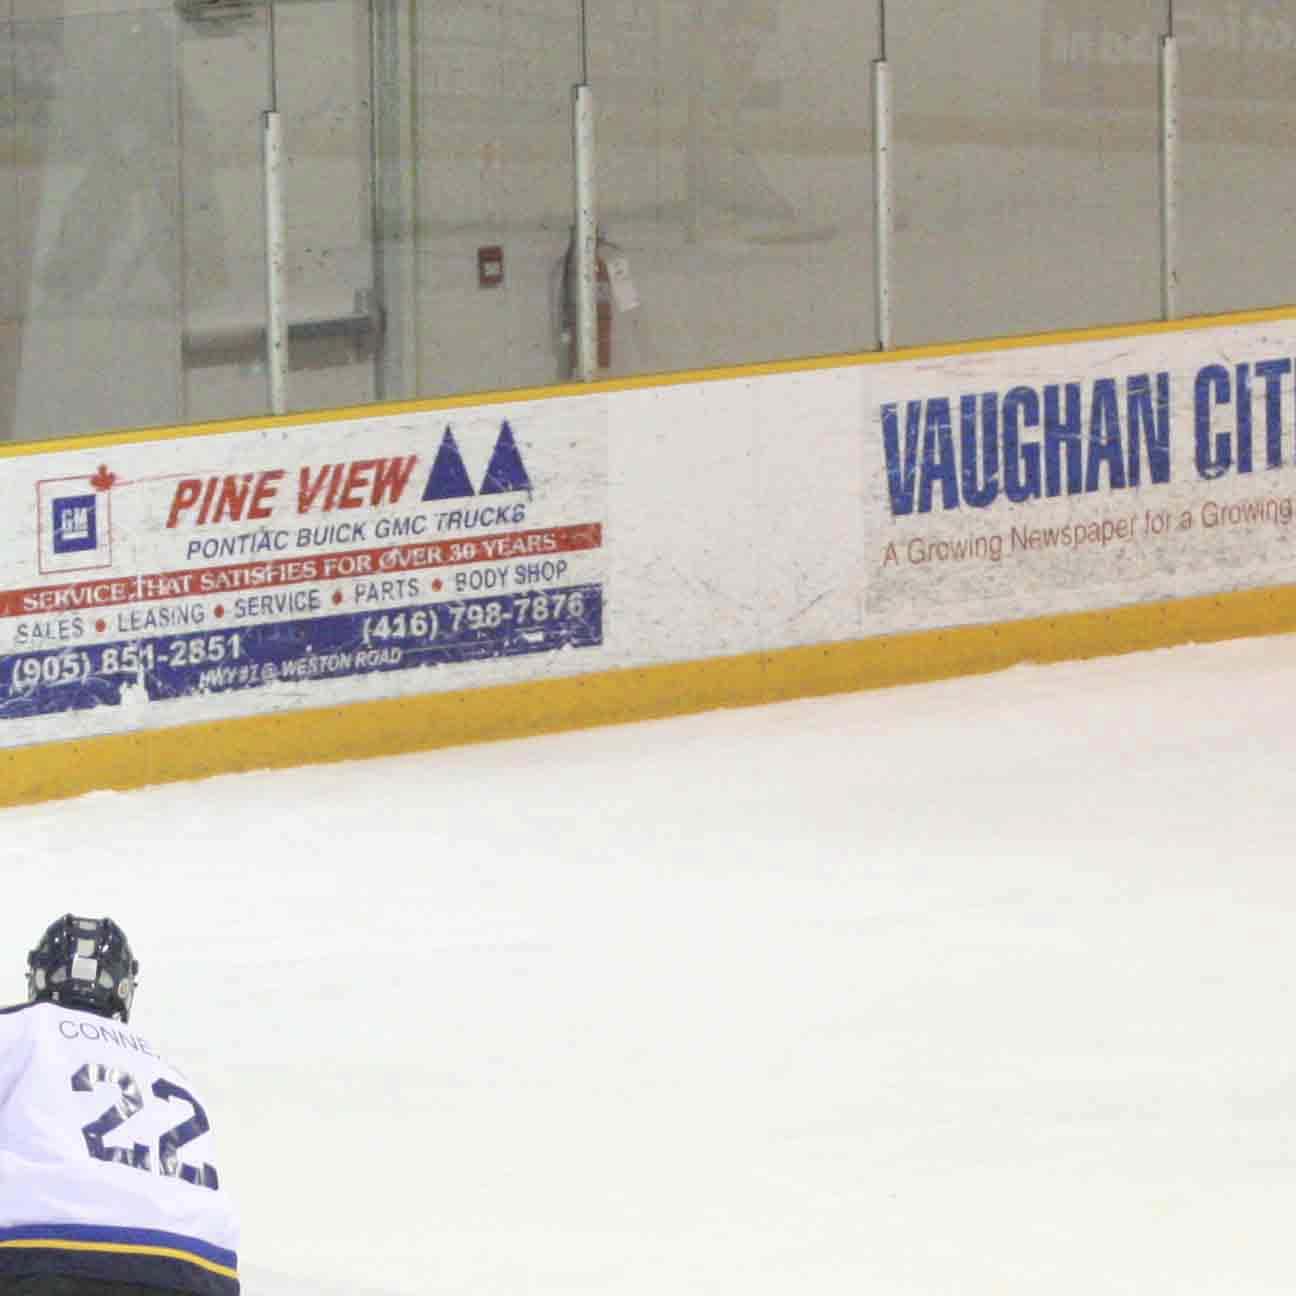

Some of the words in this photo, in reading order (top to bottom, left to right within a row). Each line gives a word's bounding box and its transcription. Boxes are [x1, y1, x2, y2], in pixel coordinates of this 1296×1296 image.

[880, 371, 1171, 516] VAUGHAN
[61, 506, 90, 534] GM
[166, 469, 286, 529] PINE
[296, 454, 419, 514] VIEW
[187, 529, 291, 560] PONTIAC
[296, 523, 368, 548] BUICK
[375, 514, 427, 540] GMC
[435, 503, 527, 531] TRUCKS
[882, 544, 898, 568] A
[907, 532, 1004, 566] Growing
[1010, 516, 1139, 555] Newspaper
[1144, 508, 1176, 534] for
[1179, 511, 1193, 531] a
[1201, 496, 1295, 532] Growing
[16, 617, 86, 645] SALES
[117, 603, 205, 632] LEASING
[234, 589, 322, 618] SERVICE
[354, 578, 420, 604] PARTS
[456, 568, 508, 593] BODY
[514, 559, 568, 584] SHOP
[23, 582, 129, 612] SERVICE
[134, 576, 193, 601] THAT
[200, 560, 317, 592] SATISFIES
[323, 553, 373, 577] FOR
[379, 544, 443, 571] OVER
[482, 533, 558, 559] YEARS
[361, 606, 439, 643] (416)
[449, 592, 584, 632] 798-7876
[12, 651, 91, 687] (905)
[102, 633, 242, 675] 851-2851
[281, 652, 353, 679] WESTON
[354, 646, 401, 668] ROAD
[70, 1063, 220, 1192] 22
